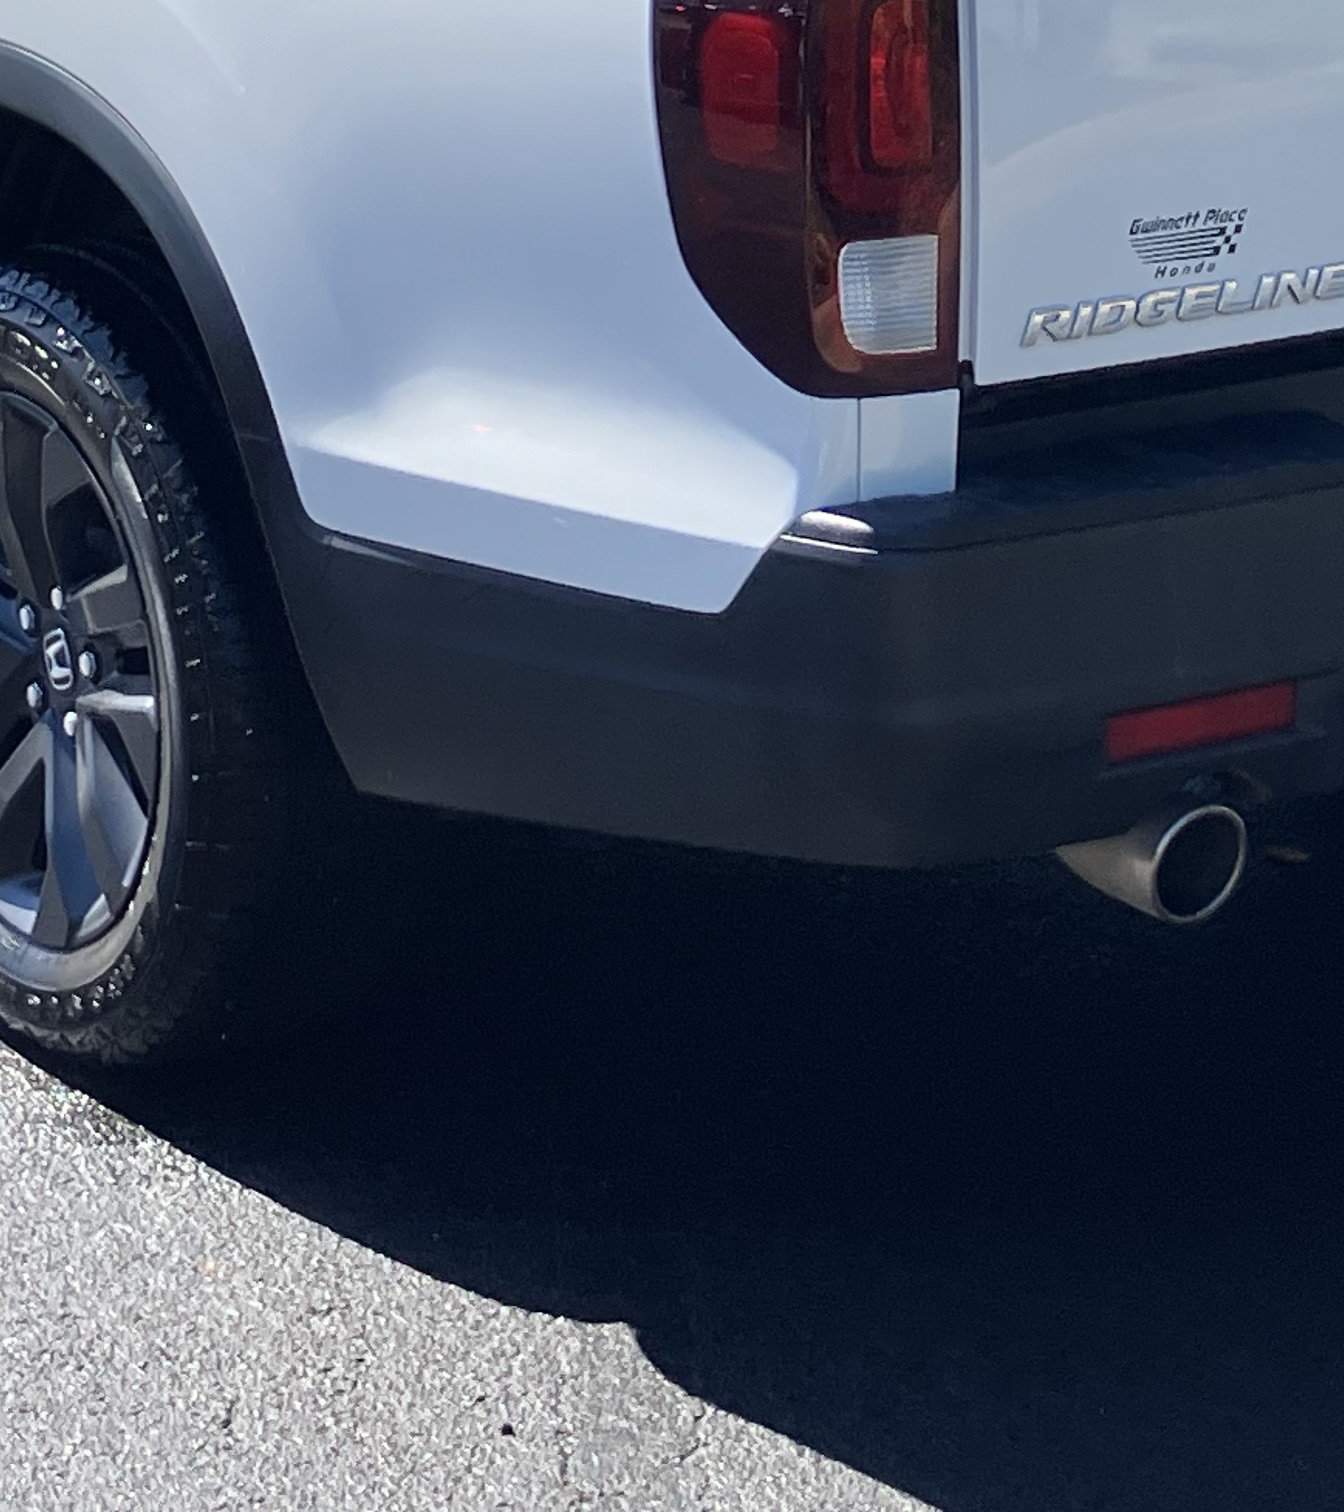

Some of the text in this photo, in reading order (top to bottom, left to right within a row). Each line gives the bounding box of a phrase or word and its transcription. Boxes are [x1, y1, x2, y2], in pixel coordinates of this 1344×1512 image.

[1129, 207, 1248, 236] Gwinnett Place
[1154, 260, 1216, 279] Honda
